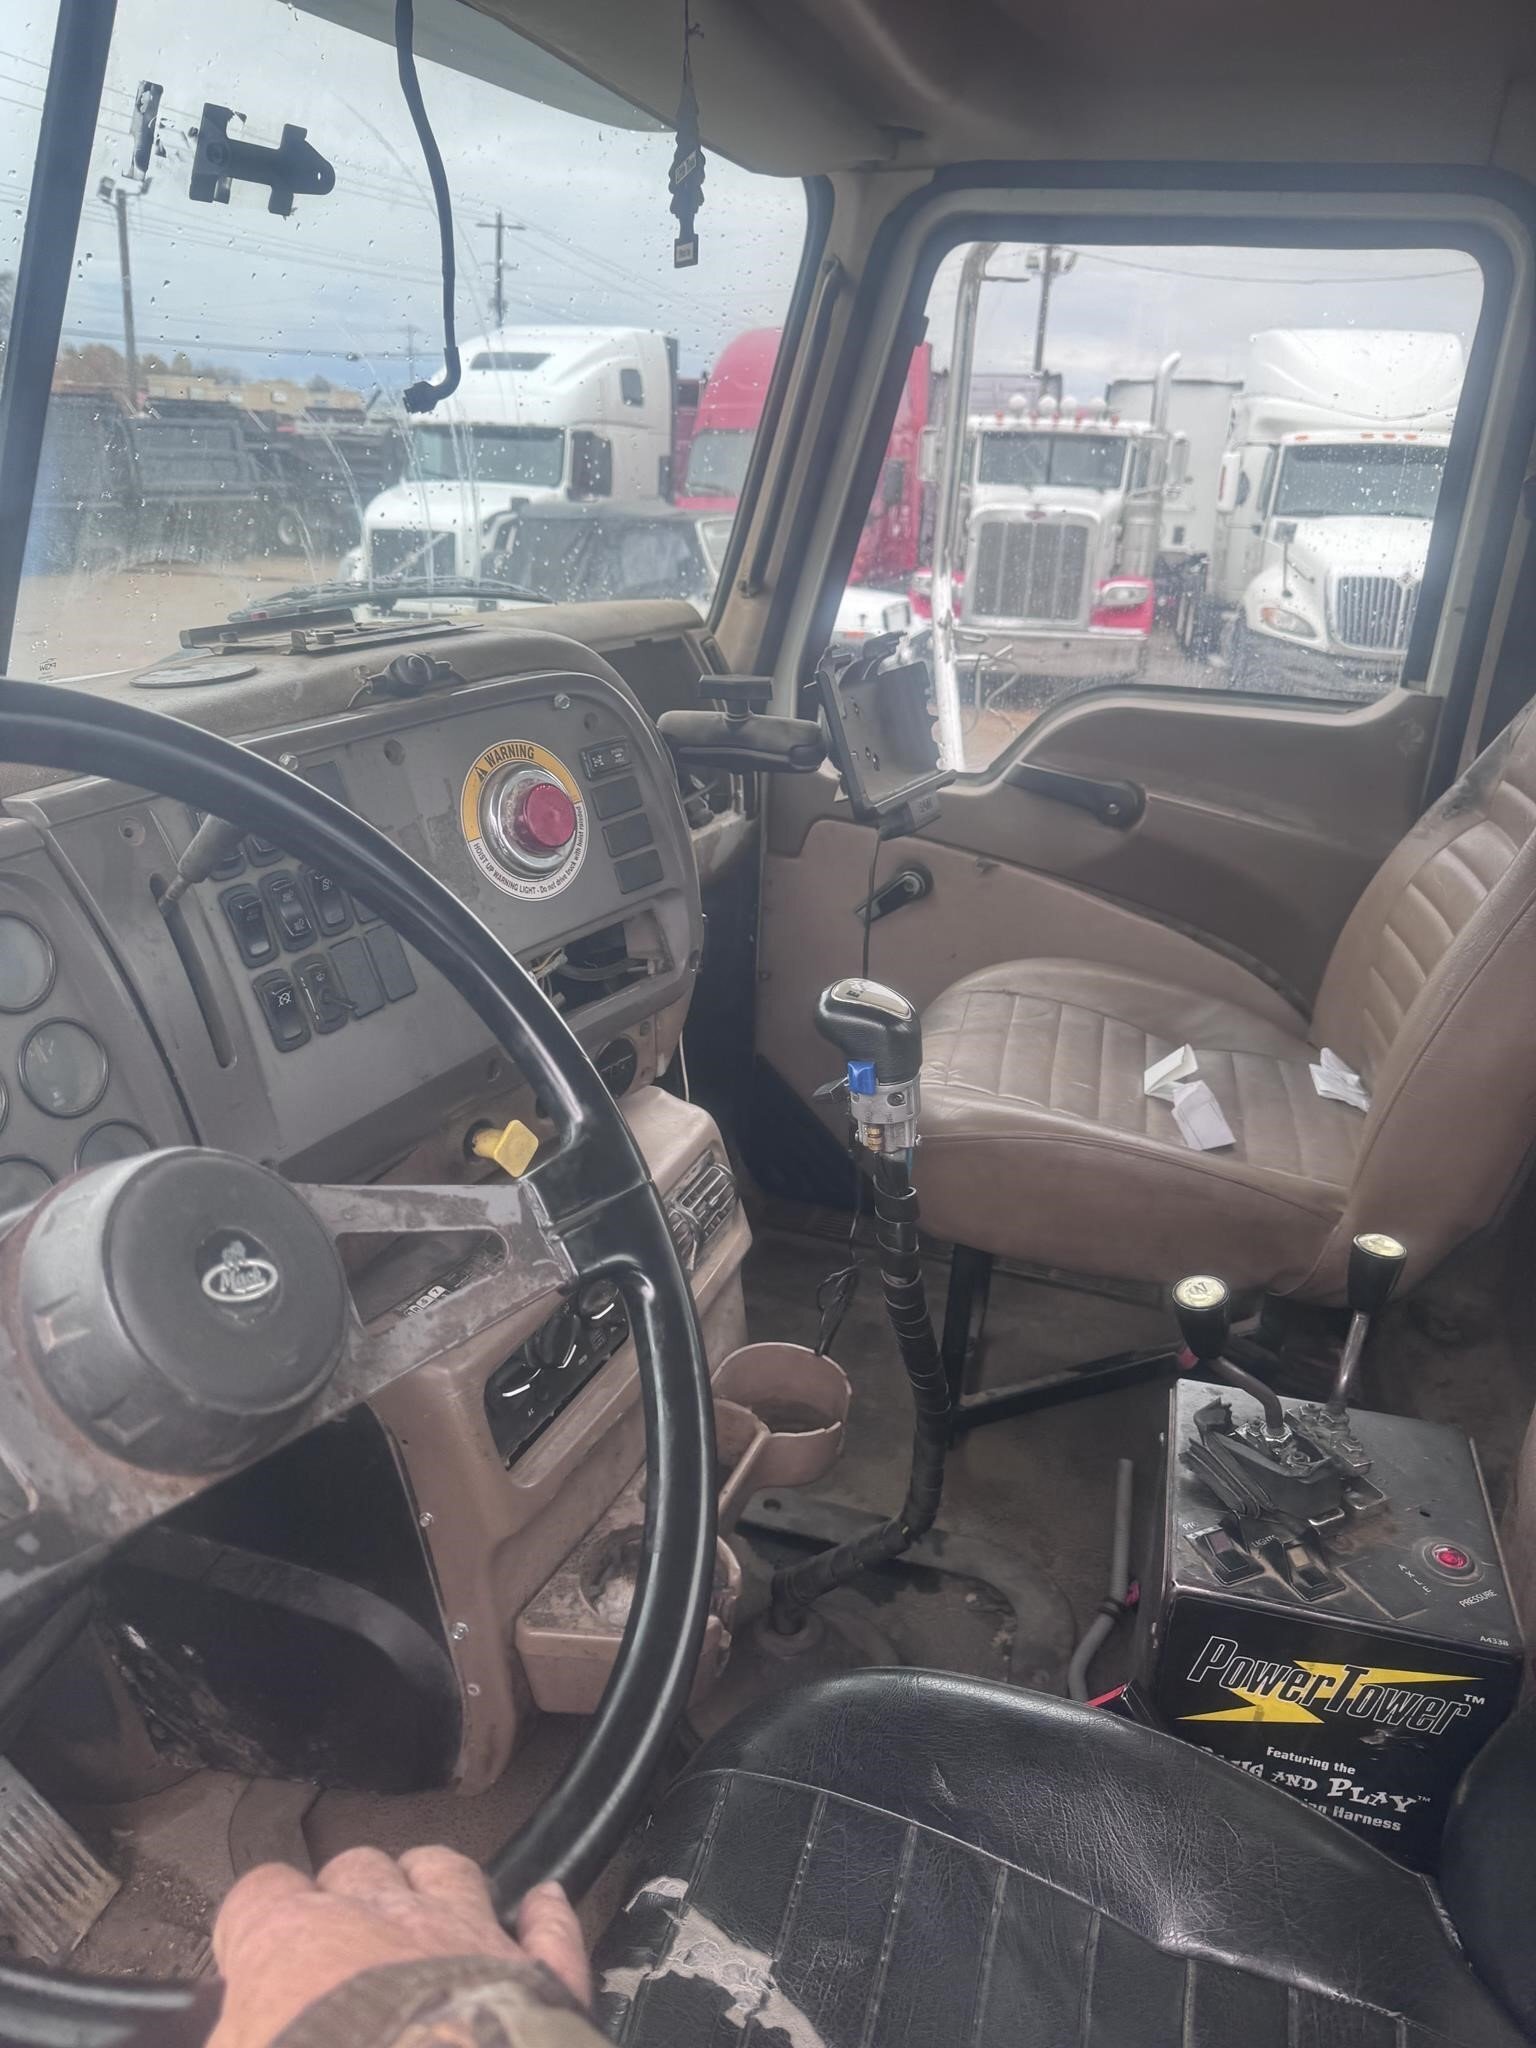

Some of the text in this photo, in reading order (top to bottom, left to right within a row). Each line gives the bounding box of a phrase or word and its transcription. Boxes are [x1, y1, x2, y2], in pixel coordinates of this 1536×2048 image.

[484, 743, 535, 768] WARNING
[473, 842, 488, 866] HOIST
[485, 860, 495, 873] UP
[493, 867, 519, 892] WARNING
[519, 885, 536, 895] LIGHT
[540, 885, 548, 894] Do
[555, 871, 568, 888] drive
[1398, 1563, 1432, 1593] AXLE
[1459, 1589, 1497, 1608] PRESSURE
[1187, 1636, 1472, 1735] PowerTower
[1266, 1746, 1330, 1771] Featuring
[1333, 1761, 1356, 1775] the
[1272, 1771, 1318, 1791] AND
[1327, 1777, 1417, 1813] PLAY
[1332, 1806, 1402, 1832] Harness
